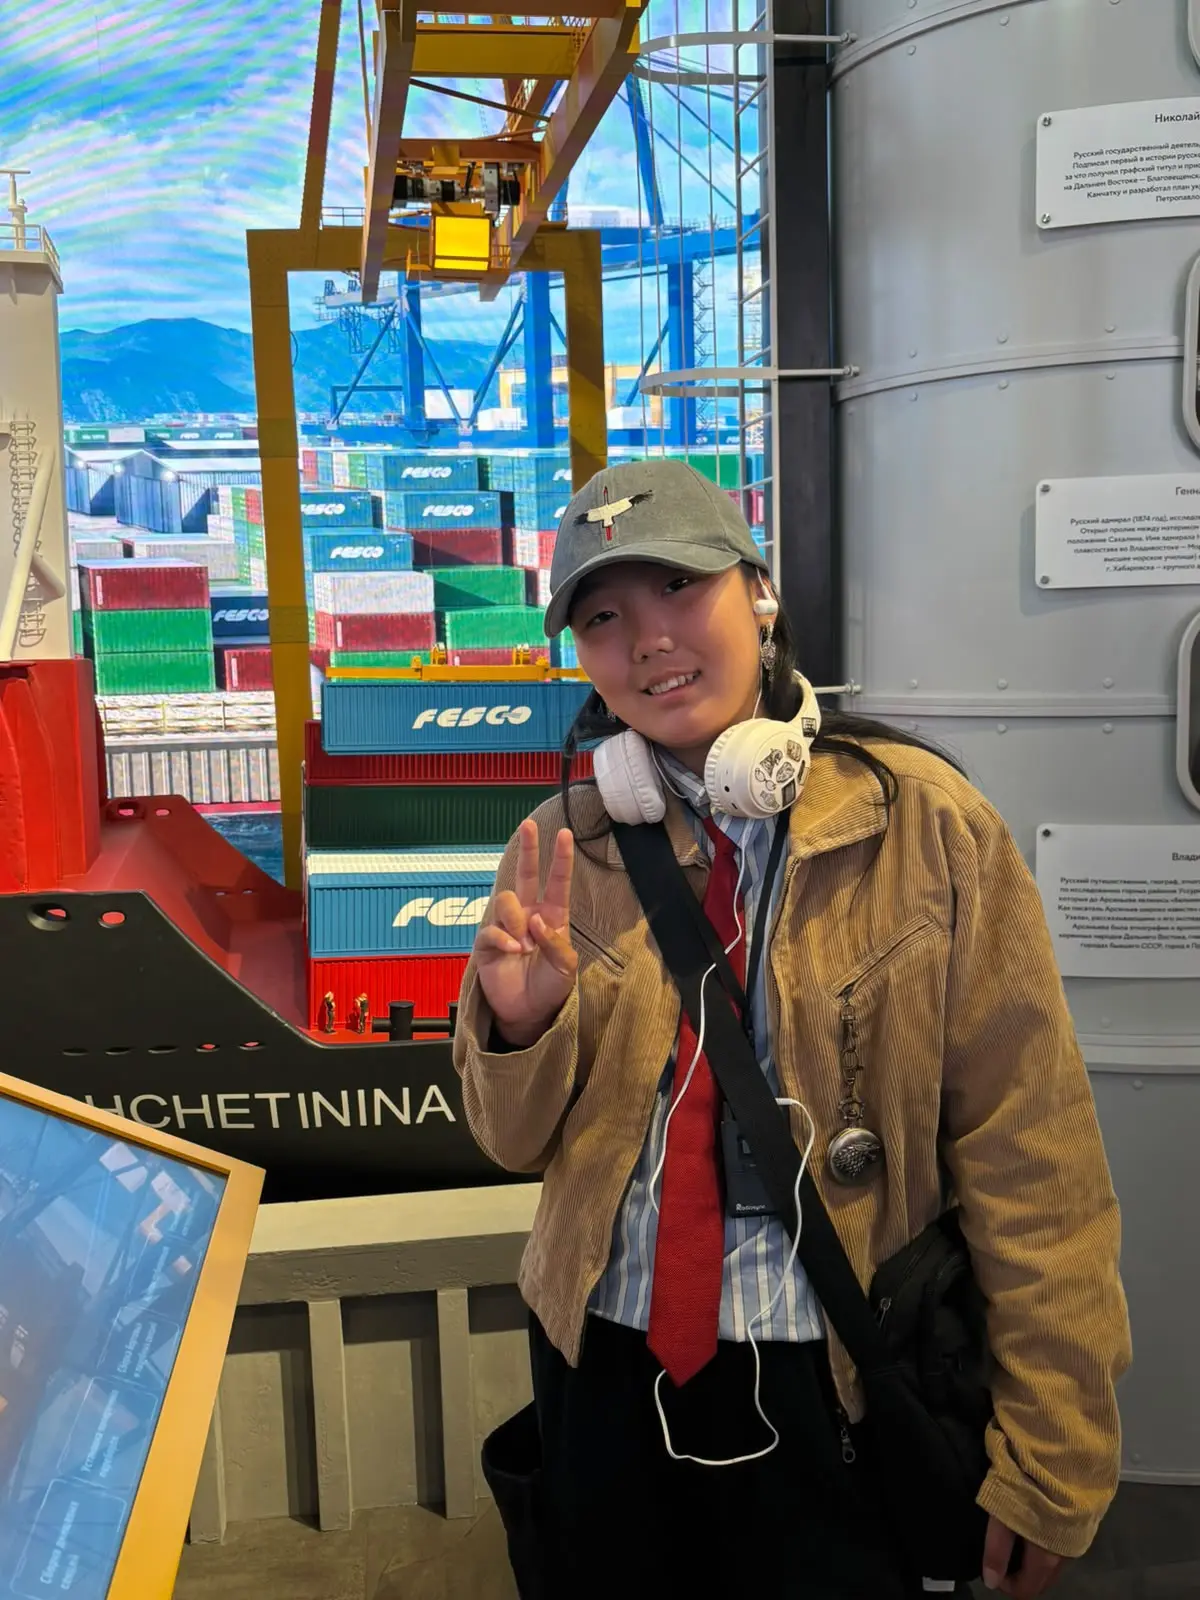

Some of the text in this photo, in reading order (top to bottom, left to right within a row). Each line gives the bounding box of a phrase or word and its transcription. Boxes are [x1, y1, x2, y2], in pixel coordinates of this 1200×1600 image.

[1155, 112, 1200, 123] Николай
[1074, 149, 1104, 159] Русский
[1105, 143, 1169, 155] государственный
[1073, 160, 1108, 169] Подписал
[1110, 156, 1138, 165] первый
[1146, 154, 1176, 162] истории
[1088, 170, 1118, 178] получил
[1120, 164, 1155, 175] графский
[1074, 180, 1106, 191] Дальнем
[1108, 178, 1138, 186] Востоке
[1087, 189, 1121, 199] Камчатку
[1129, 185, 1171, 196] разработал
[401, 466, 452, 478] FESCO
[423, 504, 474, 516] FESCO
[1070, 517, 1099, 525] Русский
[1101, 517, 1131, 525] адмирал
[330, 546, 384, 558] FESCO
[213, 608, 270, 622] FESCO
[412, 705, 532, 729] FESCO
